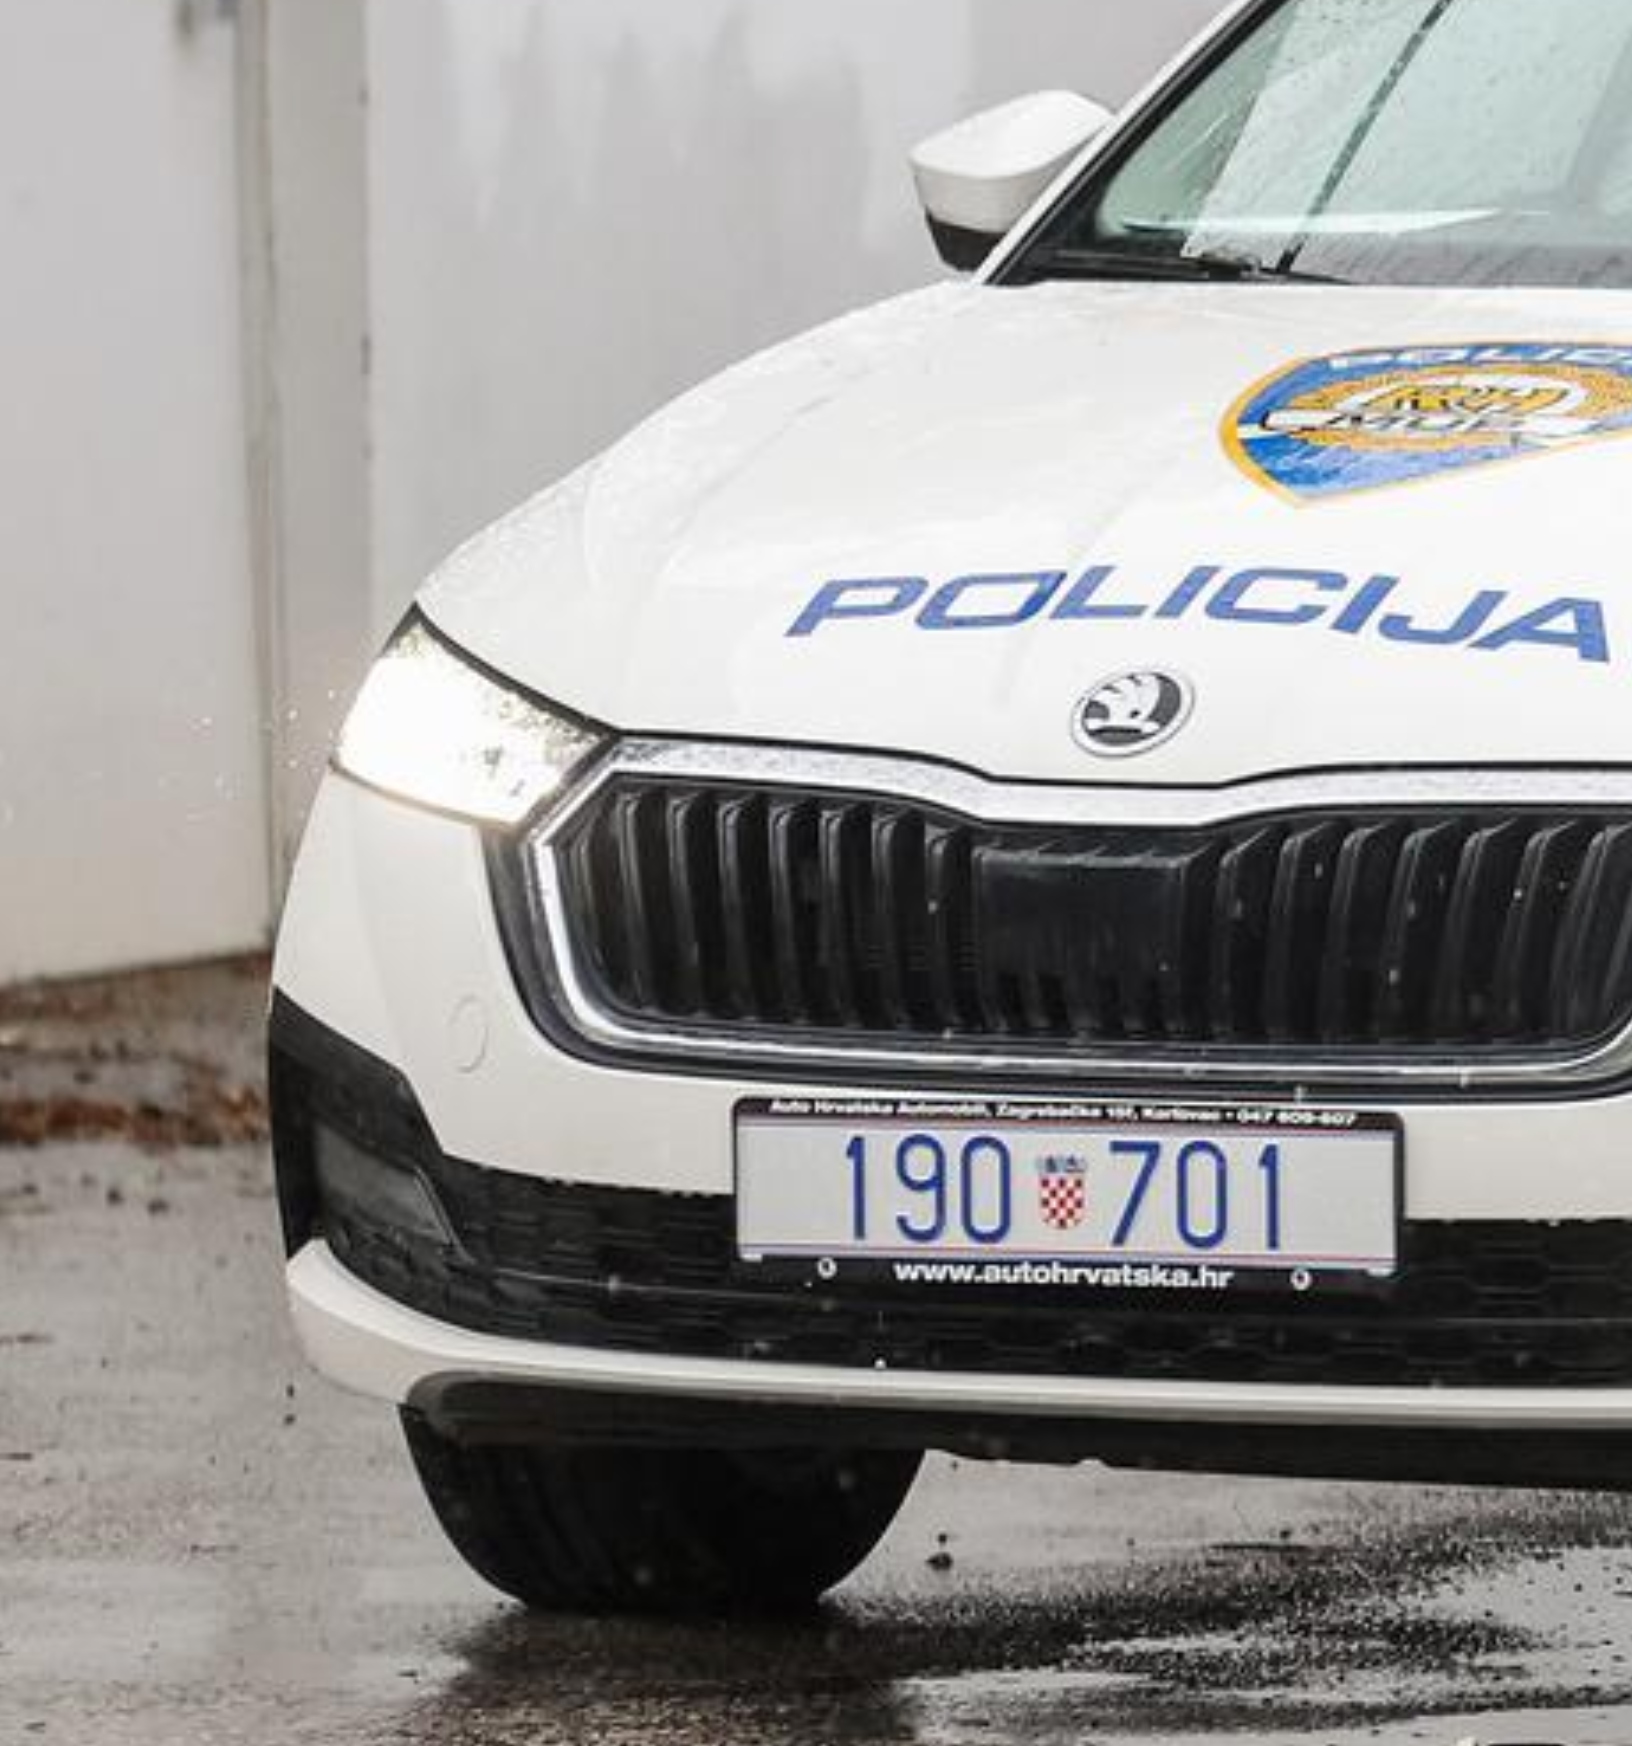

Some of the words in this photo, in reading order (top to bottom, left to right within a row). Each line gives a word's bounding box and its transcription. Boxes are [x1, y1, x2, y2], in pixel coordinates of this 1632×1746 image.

[785, 565, 1611, 664] POLICIJA
[769, 1099, 810, 1114] Auto
[814, 1100, 894, 1114] Hrvatska
[846, 1134, 1011, 1243] 190
[1109, 1140, 1279, 1249] 701
[893, 1261, 1235, 1289] www.autohrvatska.hr
